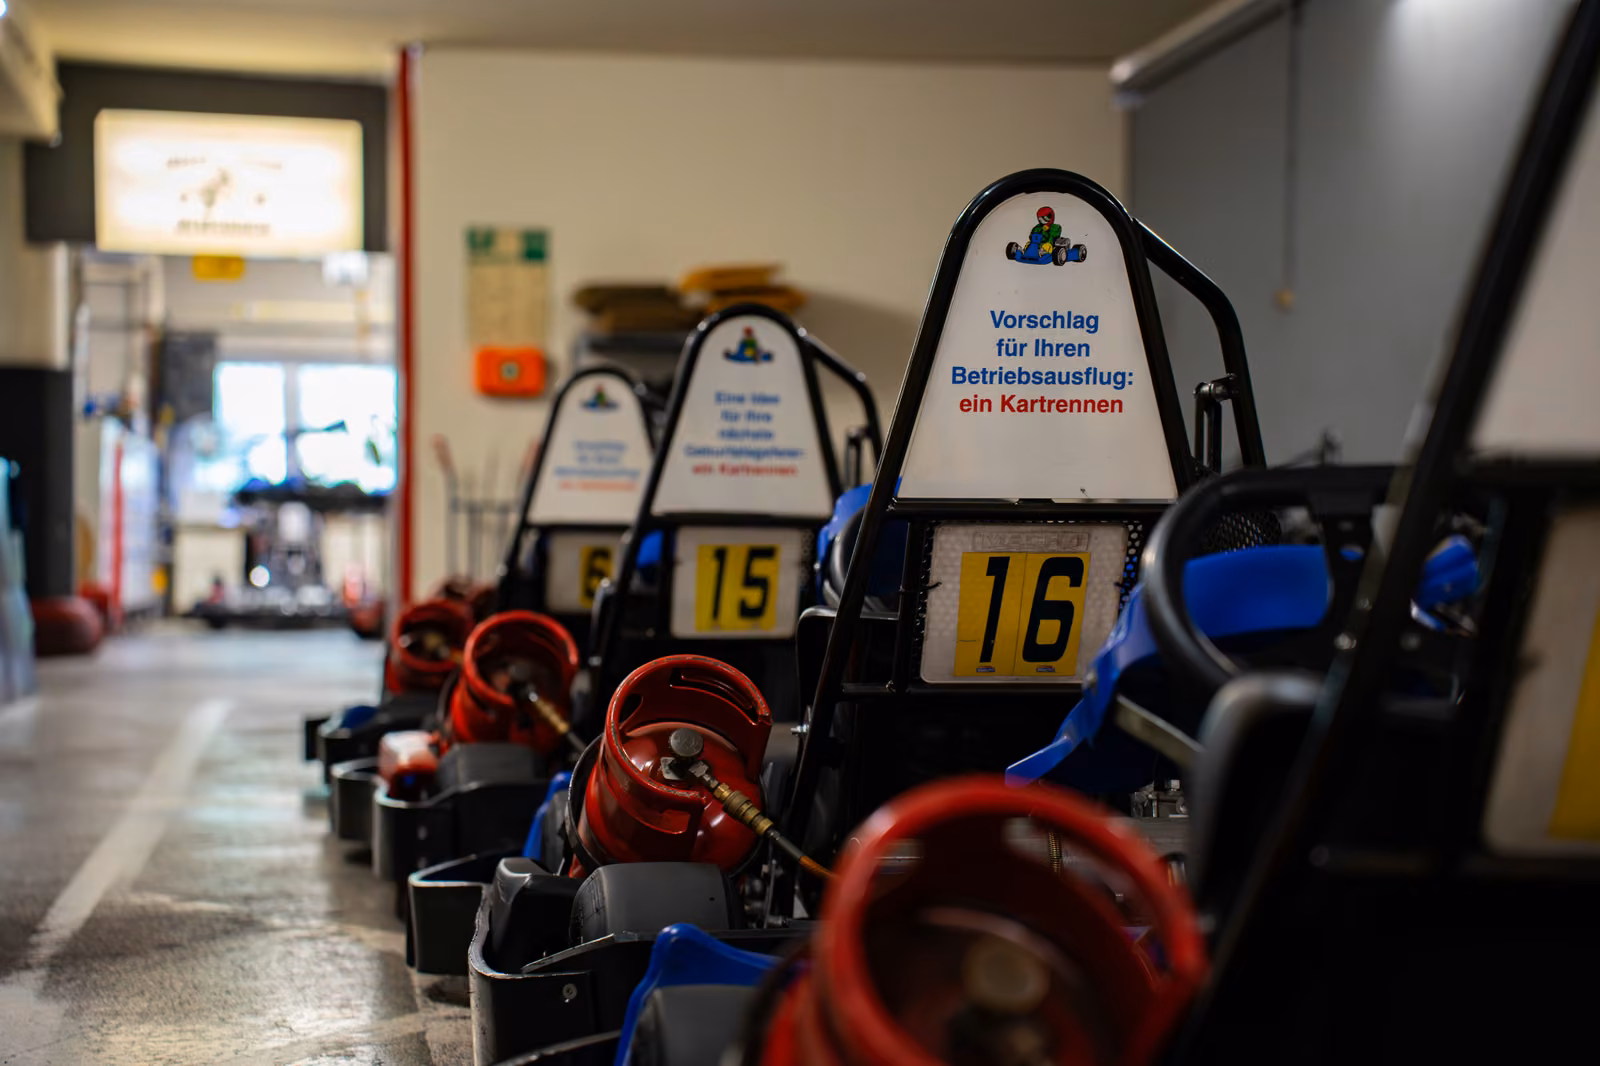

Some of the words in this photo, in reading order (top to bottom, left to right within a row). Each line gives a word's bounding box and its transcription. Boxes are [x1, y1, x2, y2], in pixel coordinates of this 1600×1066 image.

[990, 310, 1099, 334] Vorschlag
[996, 338, 1027, 357] für
[1034, 338, 1090, 357] Ihren
[951, 366, 1134, 390] Betriebsausflug:
[959, 394, 992, 413] ein
[1000, 394, 1123, 413] Kartrennen
[711, 547, 775, 620] 15
[979, 556, 1084, 663] 16
